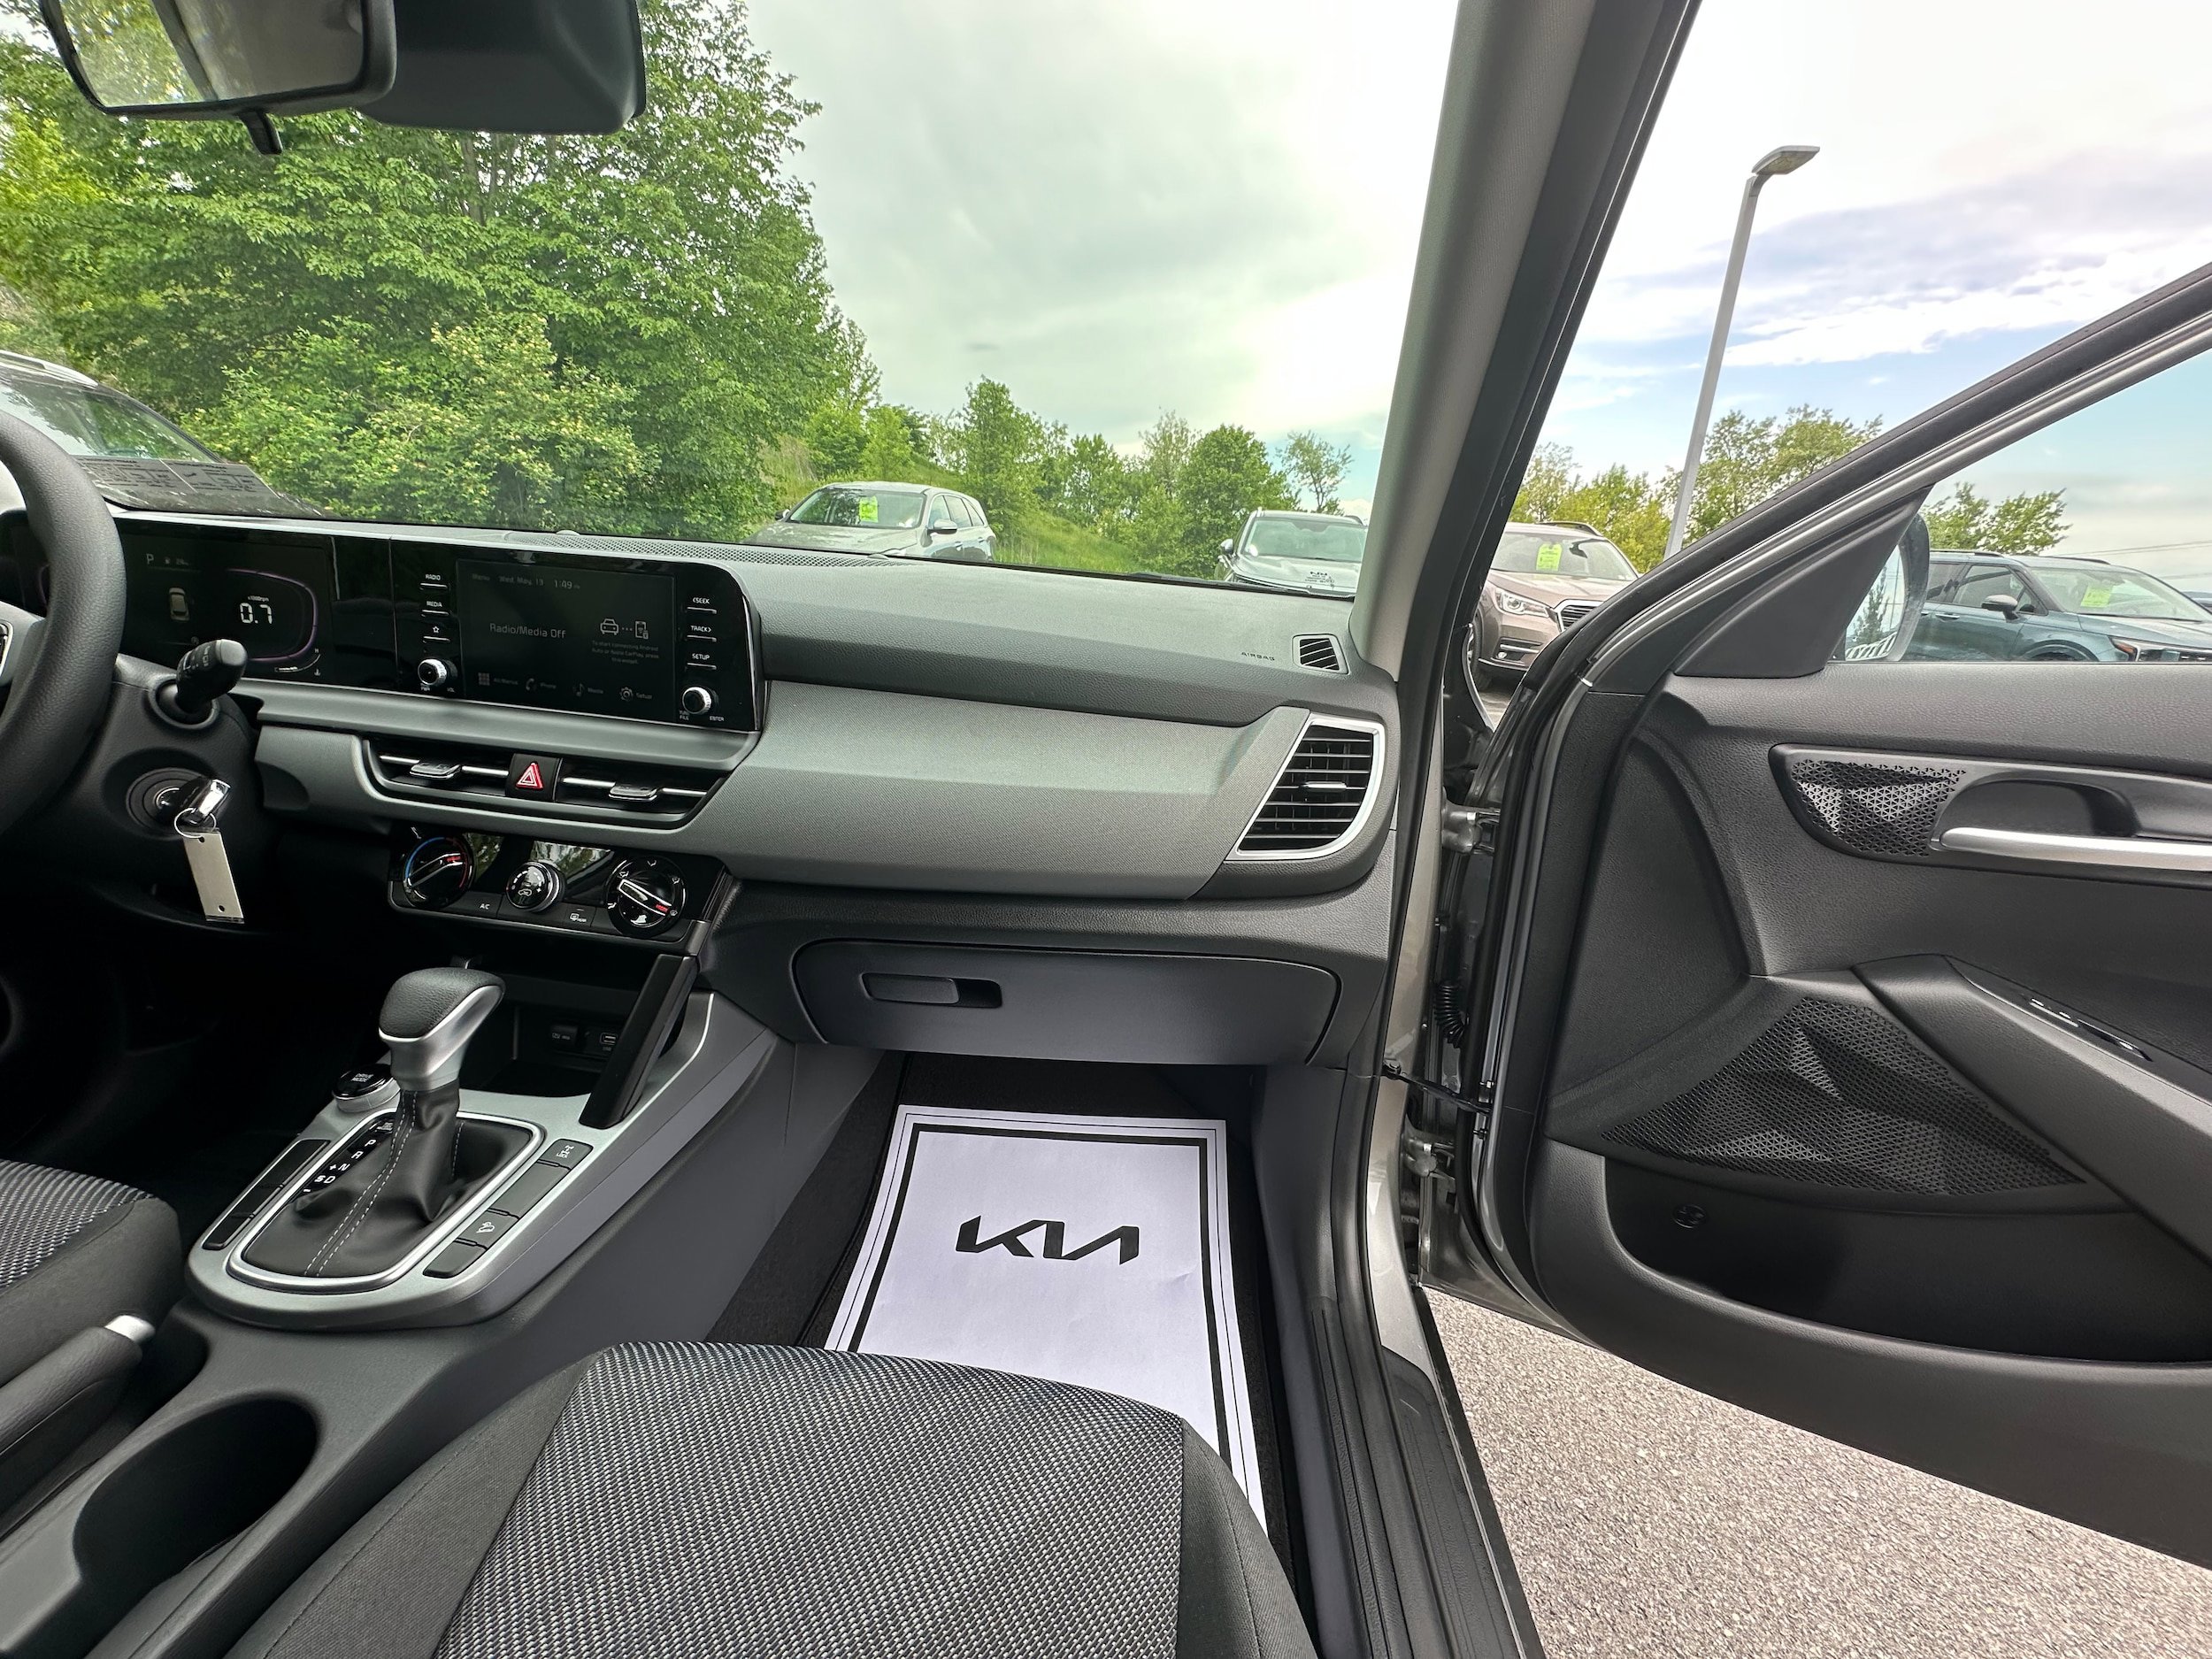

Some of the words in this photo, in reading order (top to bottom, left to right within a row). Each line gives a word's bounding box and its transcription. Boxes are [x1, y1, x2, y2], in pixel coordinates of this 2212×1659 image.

[146, 553, 155, 565] P
[240, 602, 273, 625] 0.7
[489, 622, 548, 638] Radio/Media
[550, 628, 566, 639] Off
[1240, 651, 1275, 662] AIRBAG
[338, 1163, 351, 1171] N
[956, 1215, 1140, 1265] KIA
